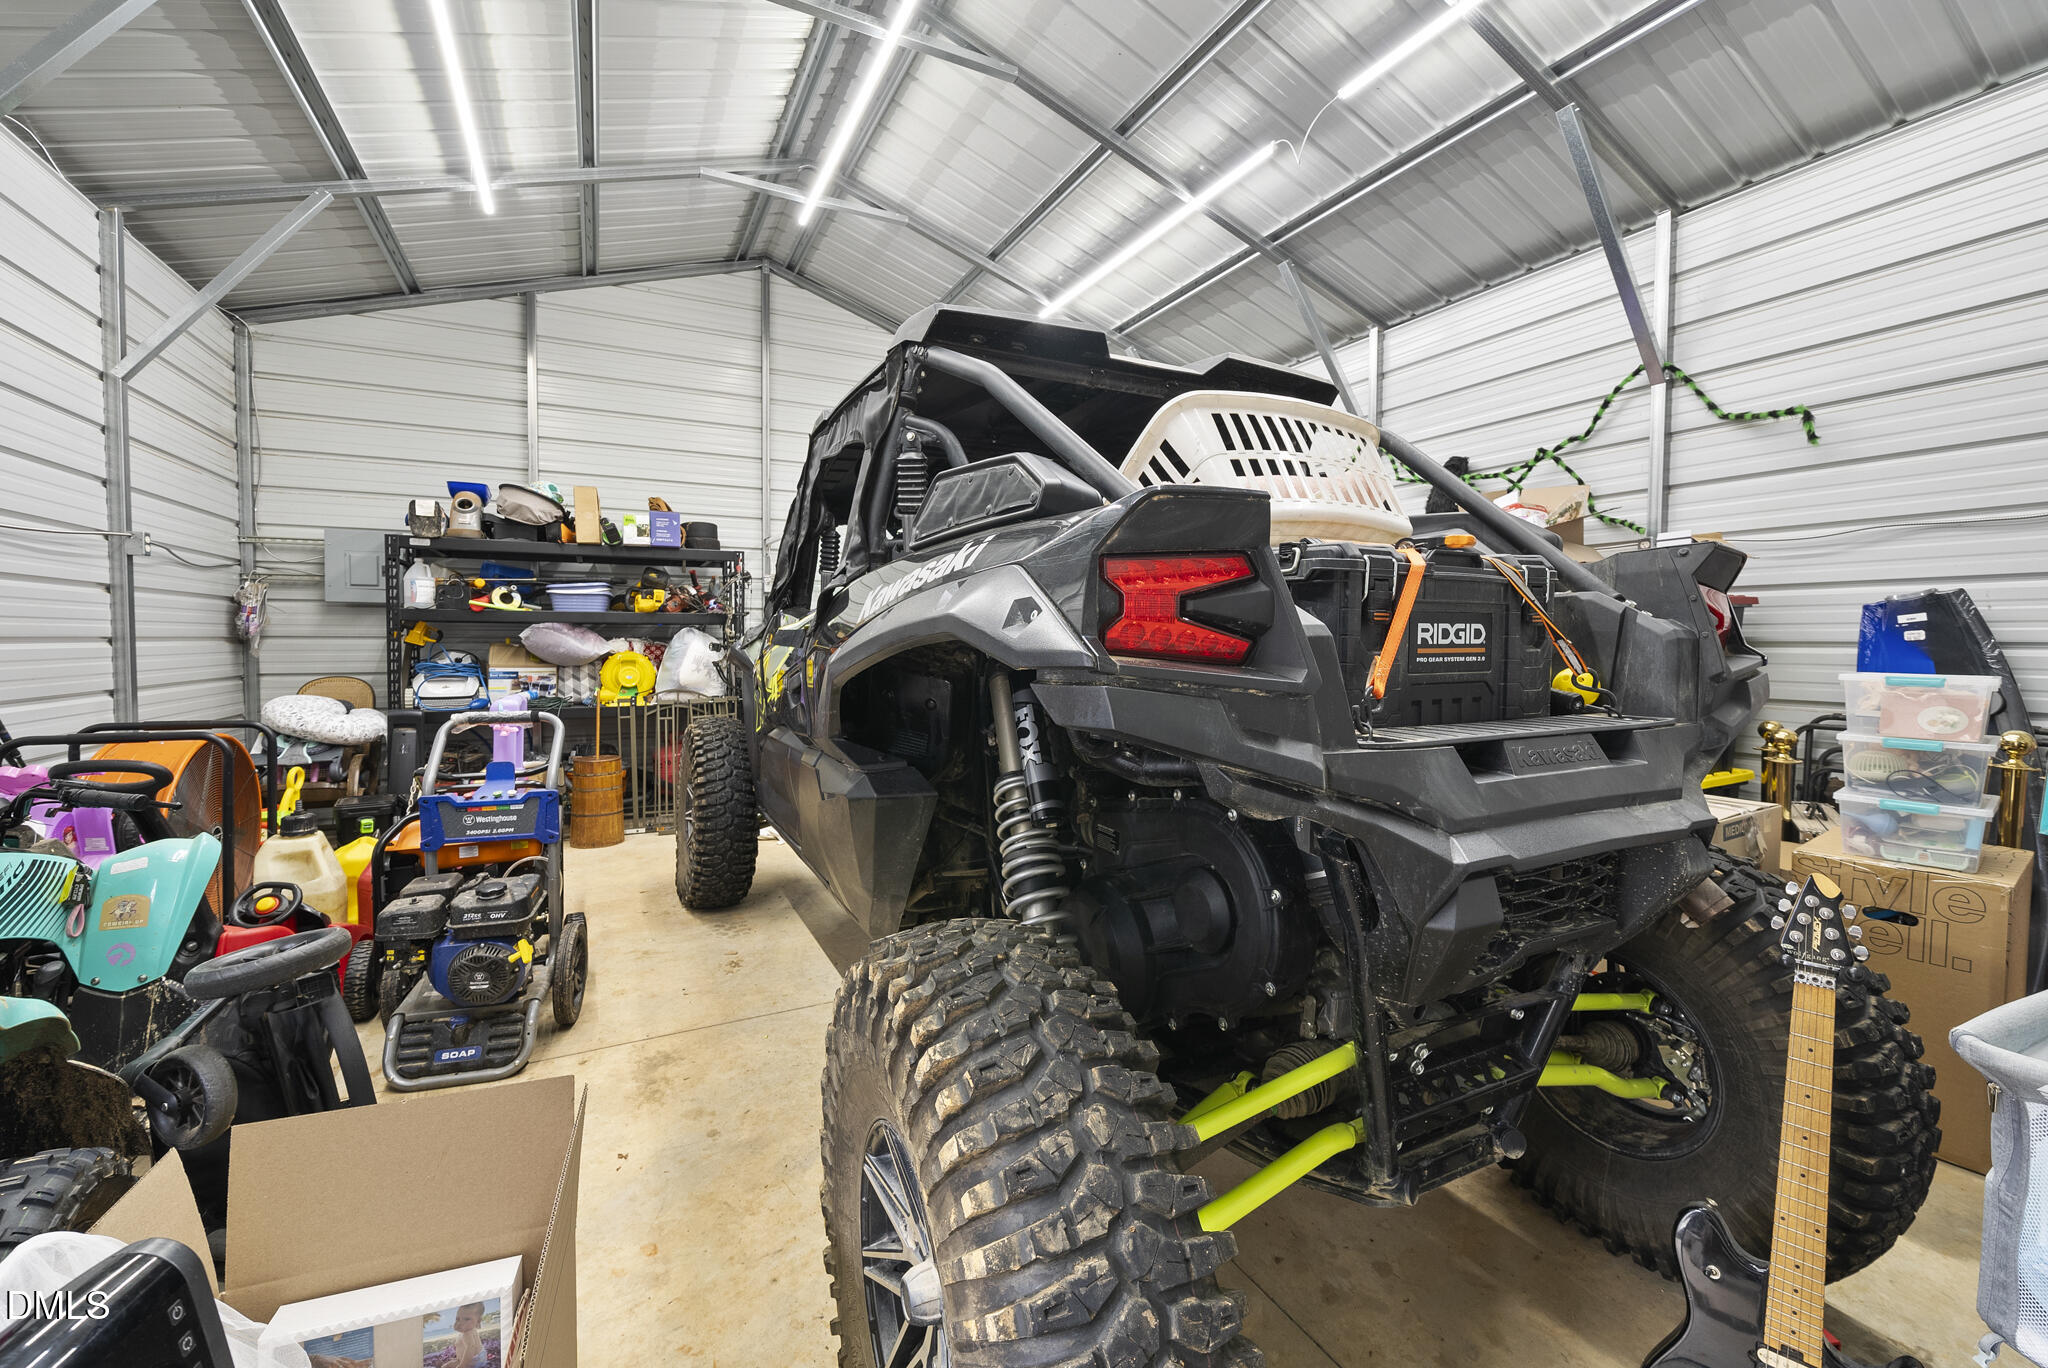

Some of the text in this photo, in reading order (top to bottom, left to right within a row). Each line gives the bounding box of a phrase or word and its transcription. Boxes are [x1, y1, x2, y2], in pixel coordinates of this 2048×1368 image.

[857, 534, 997, 624] Kawasaki
[1417, 623, 1486, 645] RIDGID
[1014, 704, 1044, 771] FOX
[1511, 740, 1602, 768] Kawasaki
[475, 815, 517, 823] Westinghouse
[1843, 904, 1972, 974] ell.
[441, 1049, 476, 1060] SOAP
